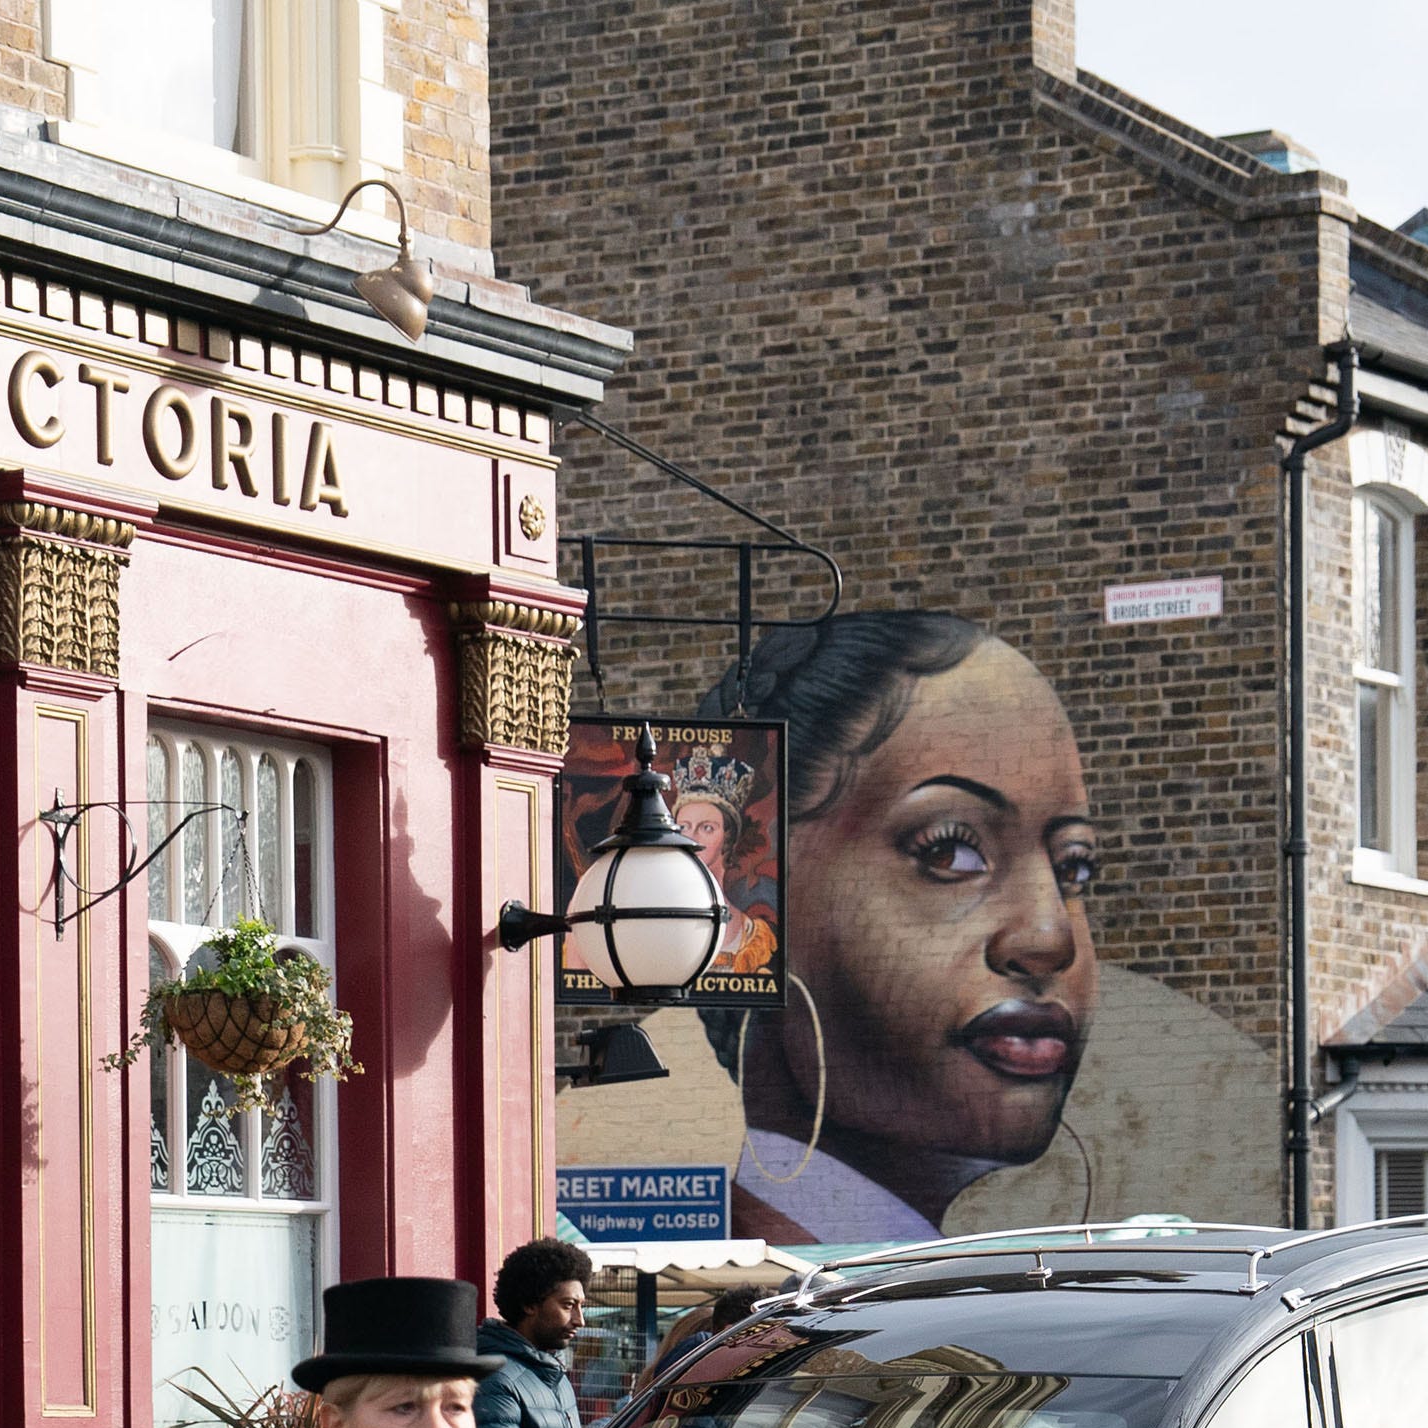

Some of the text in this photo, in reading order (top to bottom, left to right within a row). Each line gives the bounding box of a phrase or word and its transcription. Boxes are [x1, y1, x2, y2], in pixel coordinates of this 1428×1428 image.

[1112, 602, 1149, 620] BRIDGE
[1154, 599, 1191, 616] STREET
[612, 725, 733, 744] FRE HOUSE
[563, 974, 779, 993] THE ICTORIA
[556, 1174, 721, 1199] REET MARKET
[580, 1212, 720, 1232] Highway CLOSED
[168, 1300, 260, 1337] SALOON
